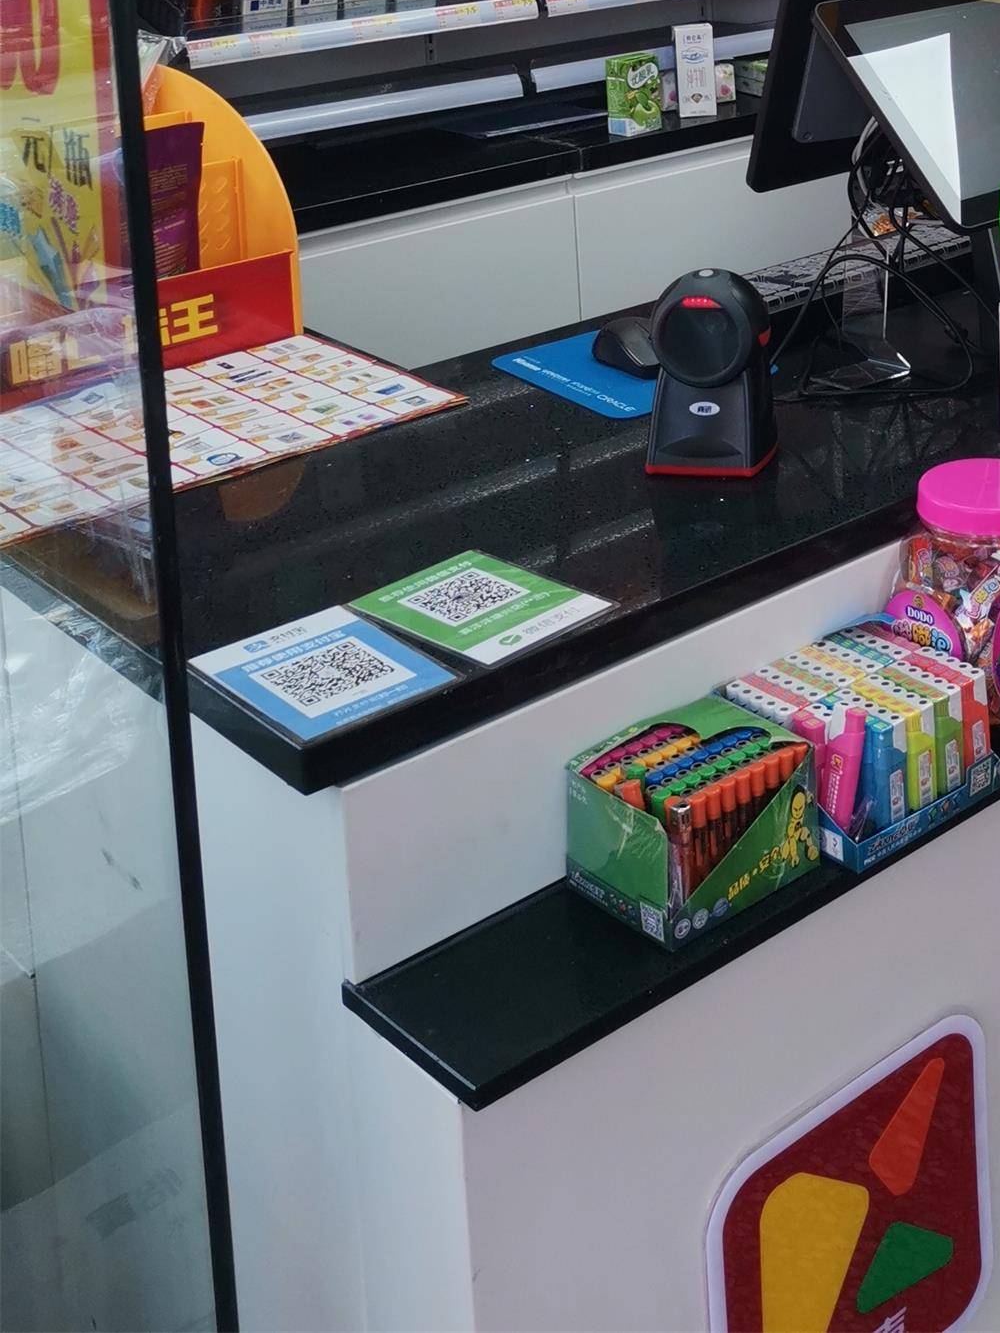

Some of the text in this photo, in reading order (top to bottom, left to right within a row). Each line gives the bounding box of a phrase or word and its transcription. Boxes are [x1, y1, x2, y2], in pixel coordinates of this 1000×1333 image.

[597, 394, 637, 412] ORACLE
[522, 606, 580, 635] 微信支付
[907, 608, 933, 625] DODO
